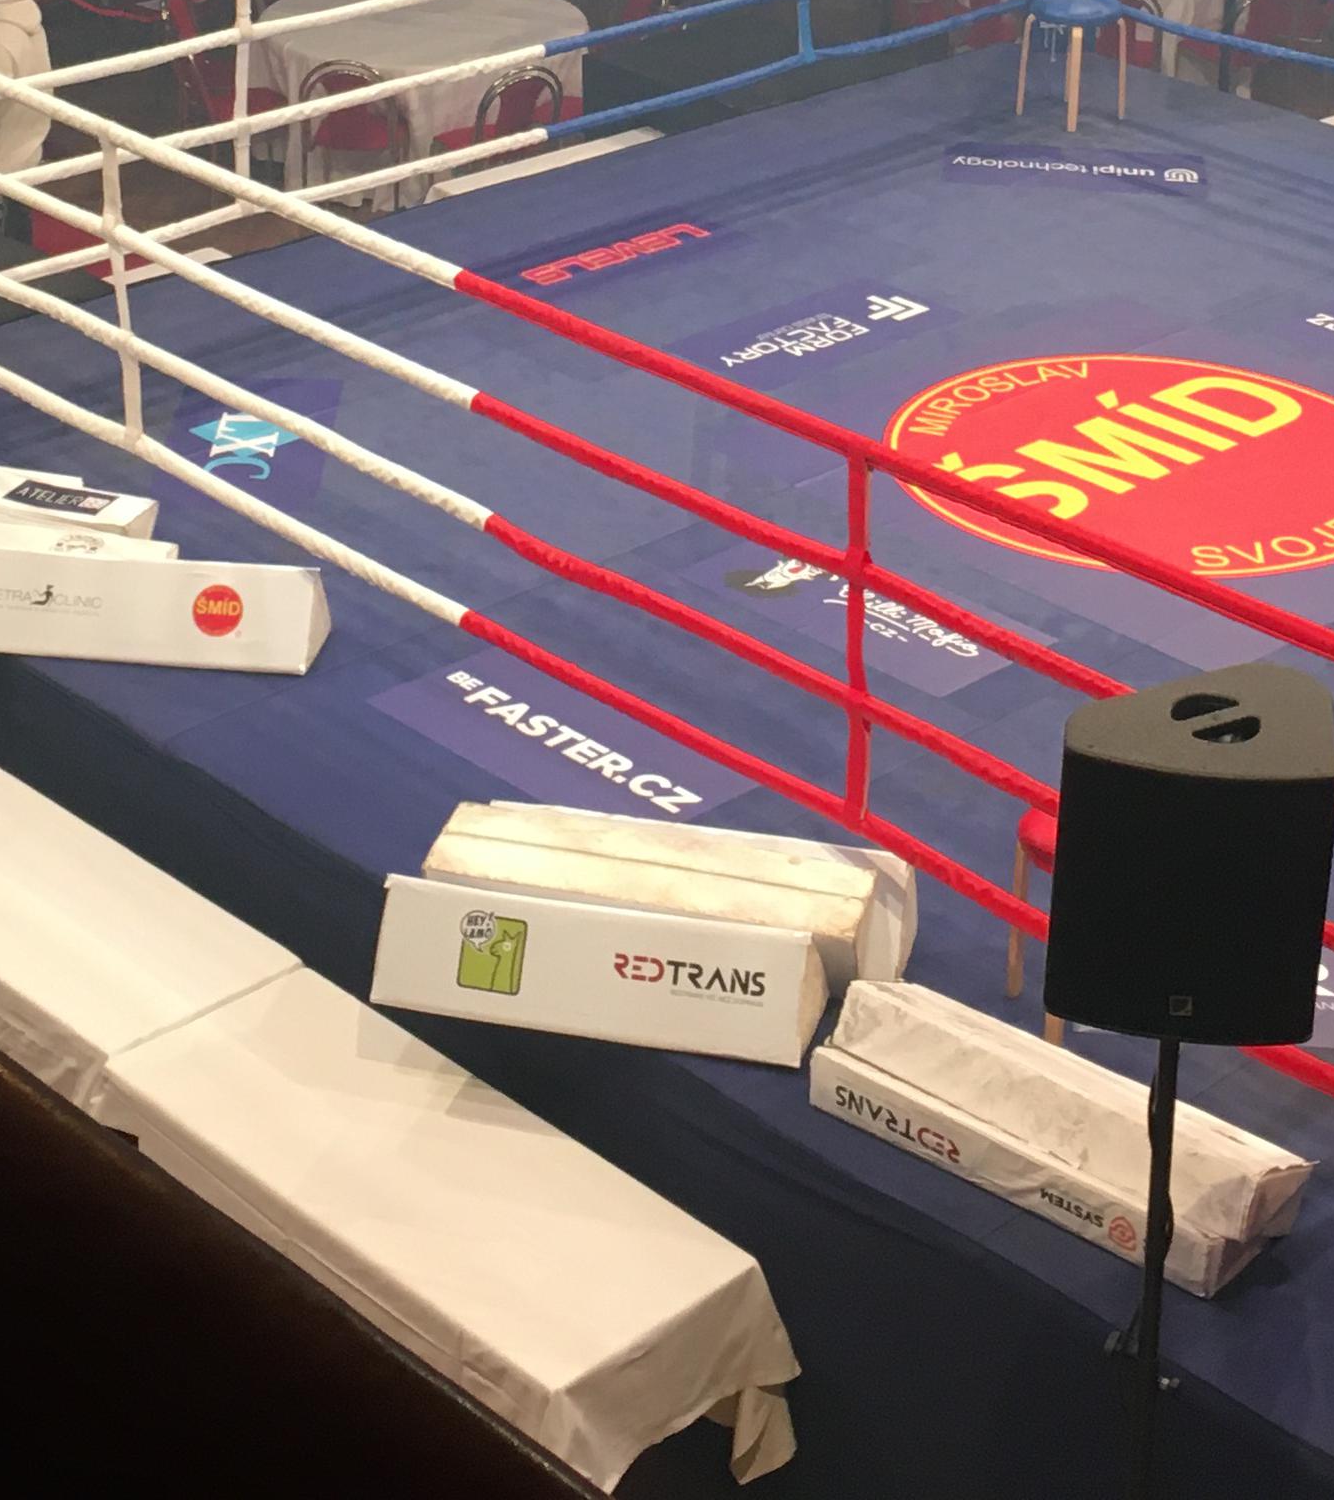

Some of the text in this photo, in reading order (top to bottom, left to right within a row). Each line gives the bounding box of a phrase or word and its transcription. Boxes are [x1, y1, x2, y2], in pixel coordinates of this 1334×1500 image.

[952, 156, 1156, 178] unipi technology
[520, 223, 712, 286] LEVELS
[720, 316, 852, 368] FACTORY
[783, 322, 870, 357] FORM
[908, 362, 1089, 437] MIROSLAV
[933, 375, 1303, 520] ŠMÍD
[14, 486, 84, 506] ATELIER
[55, 592, 104, 610] CLINIC
[195, 595, 242, 617] ŠMÍD
[446, 670, 704, 814] BE FASTER.CZ
[612, 952, 766, 998] REDTRANS
[835, 1084, 961, 1164] REDTRANS
[1038, 1186, 1104, 1228] SYSTEM
